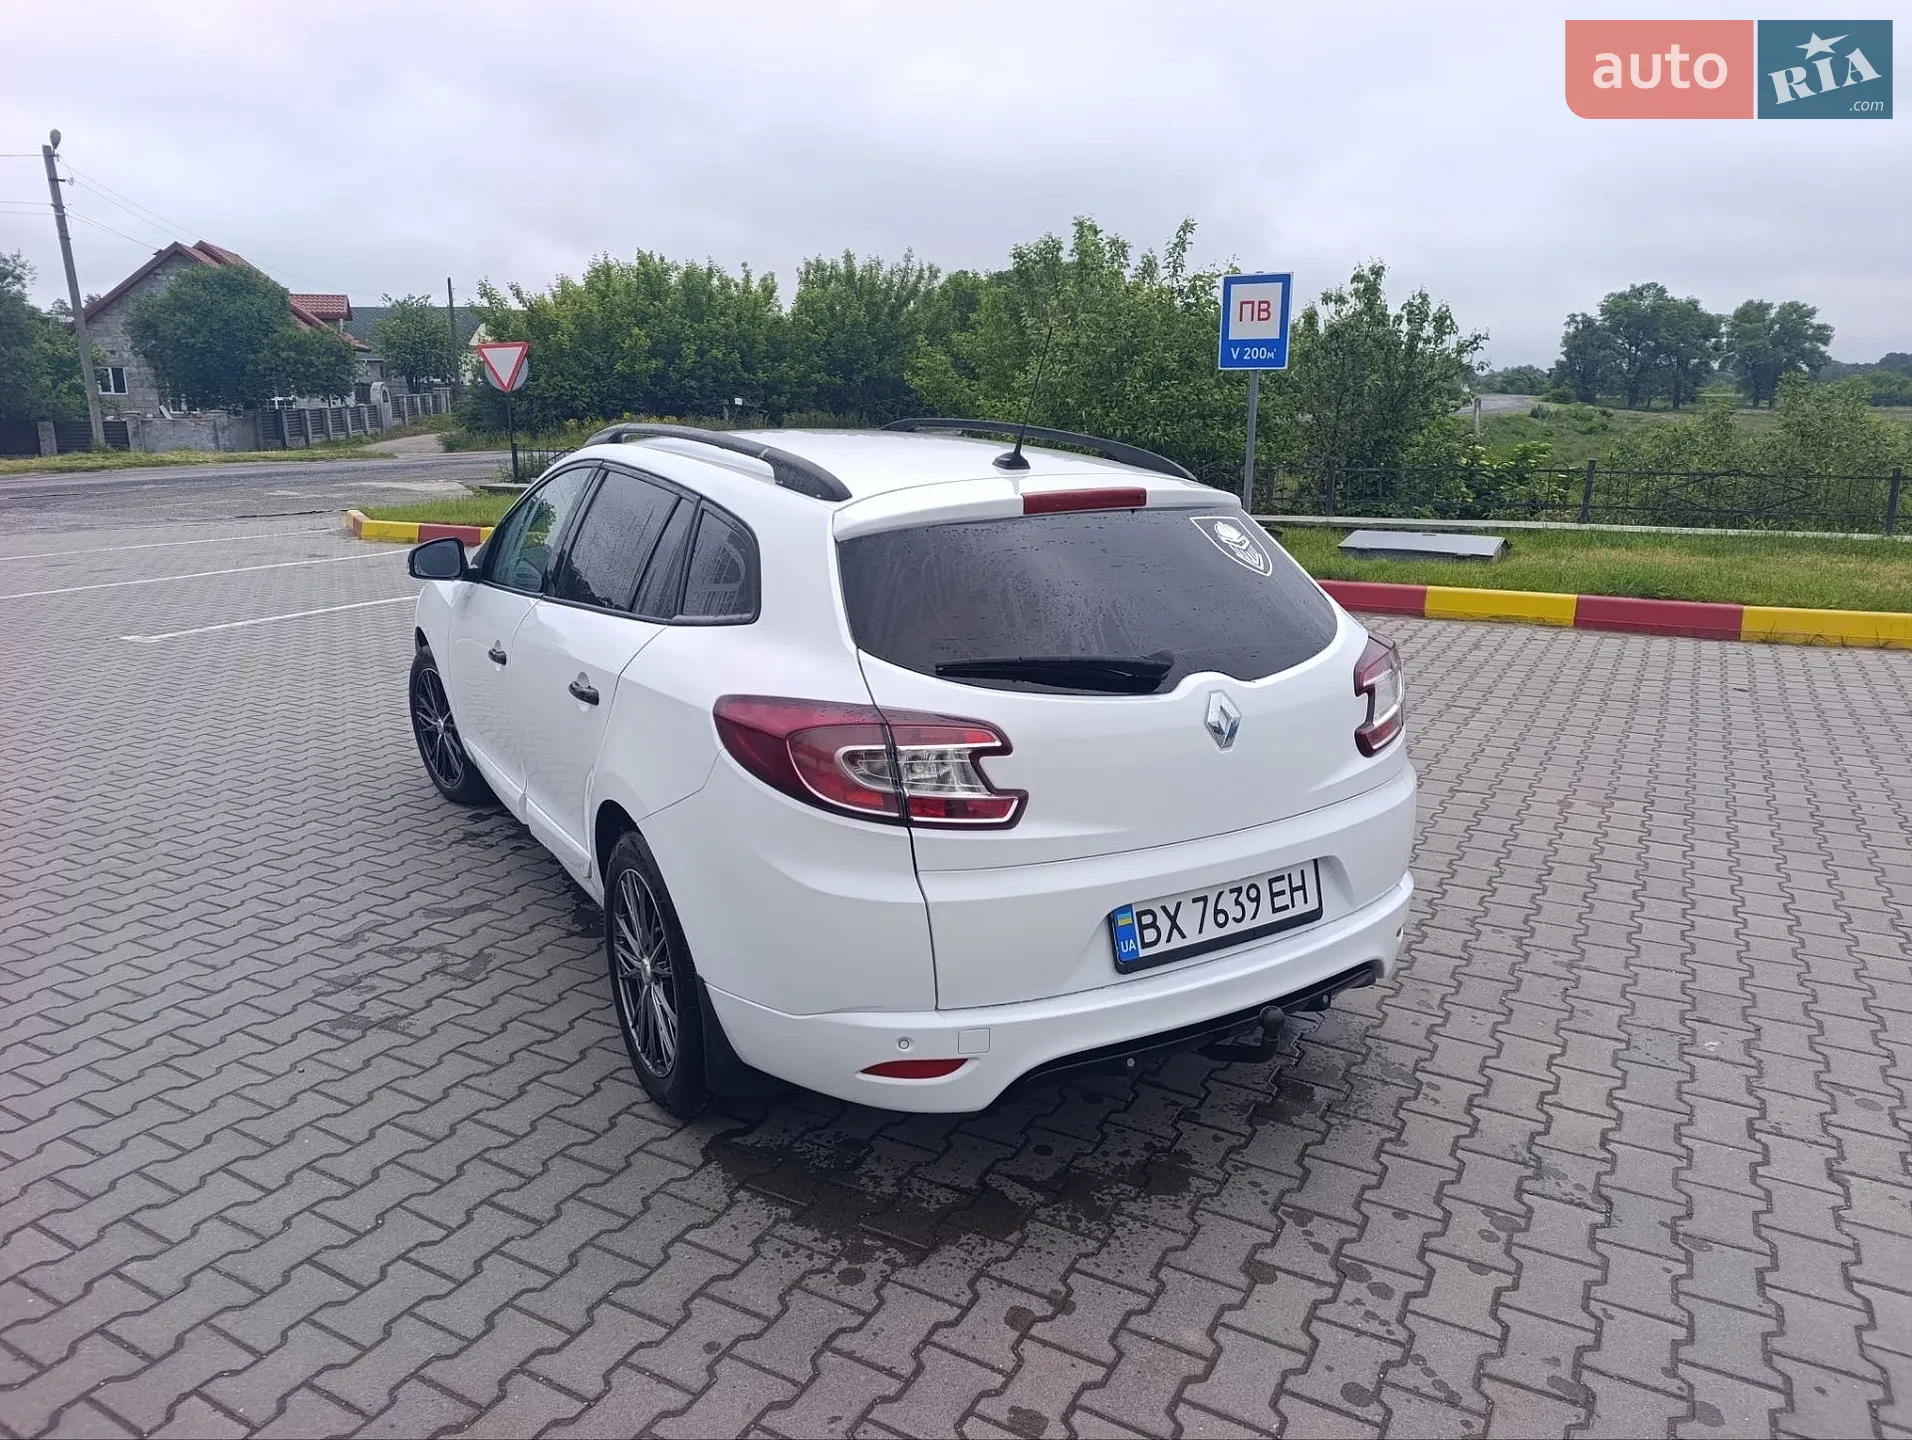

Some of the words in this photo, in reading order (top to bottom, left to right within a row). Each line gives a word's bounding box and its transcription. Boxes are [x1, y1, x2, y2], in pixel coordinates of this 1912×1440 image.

[1239, 300, 1271, 322] ПВ
[1231, 347, 1240, 359] V
[1135, 901, 1187, 950] BX
[1192, 883, 1261, 935] 7639
[1267, 869, 1308, 914] EH
[1121, 941, 1136, 953] UA
